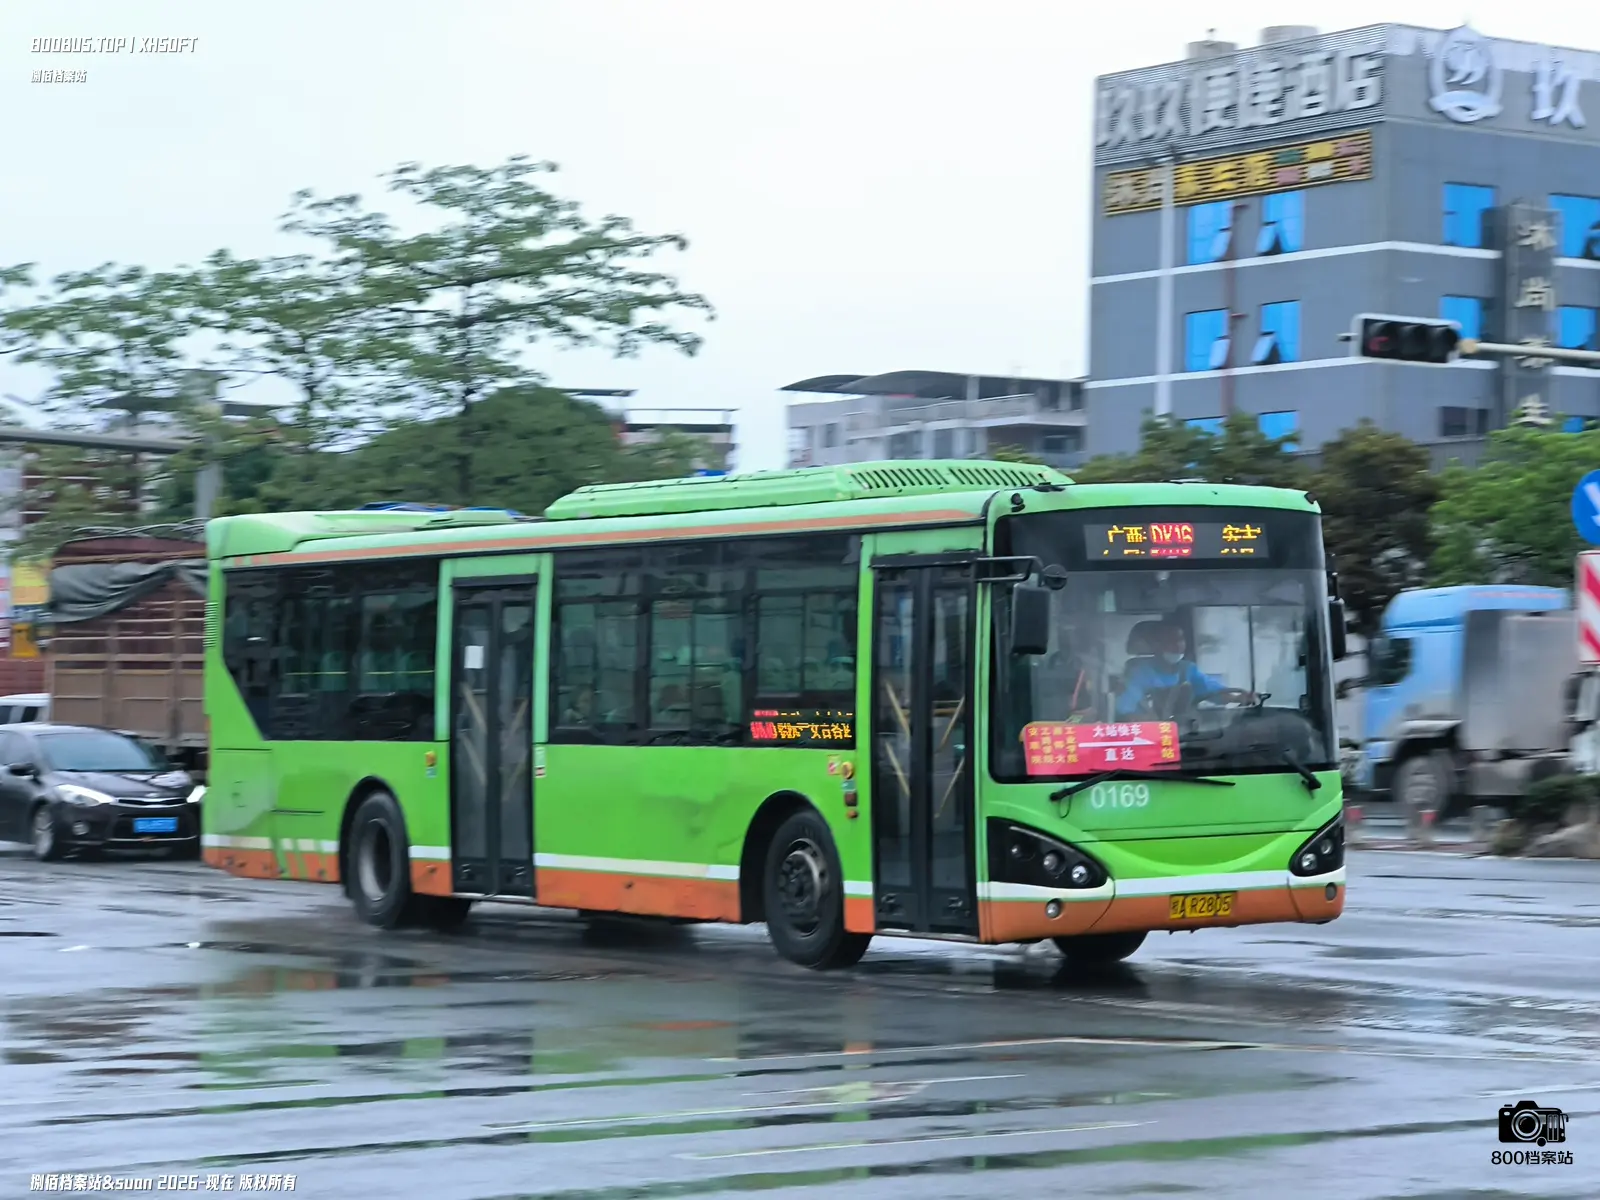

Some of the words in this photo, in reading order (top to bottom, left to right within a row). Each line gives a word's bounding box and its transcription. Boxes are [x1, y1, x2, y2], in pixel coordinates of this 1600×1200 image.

[1092, 723, 1143, 738] 大站快车
[1090, 783, 1150, 809] 0169
